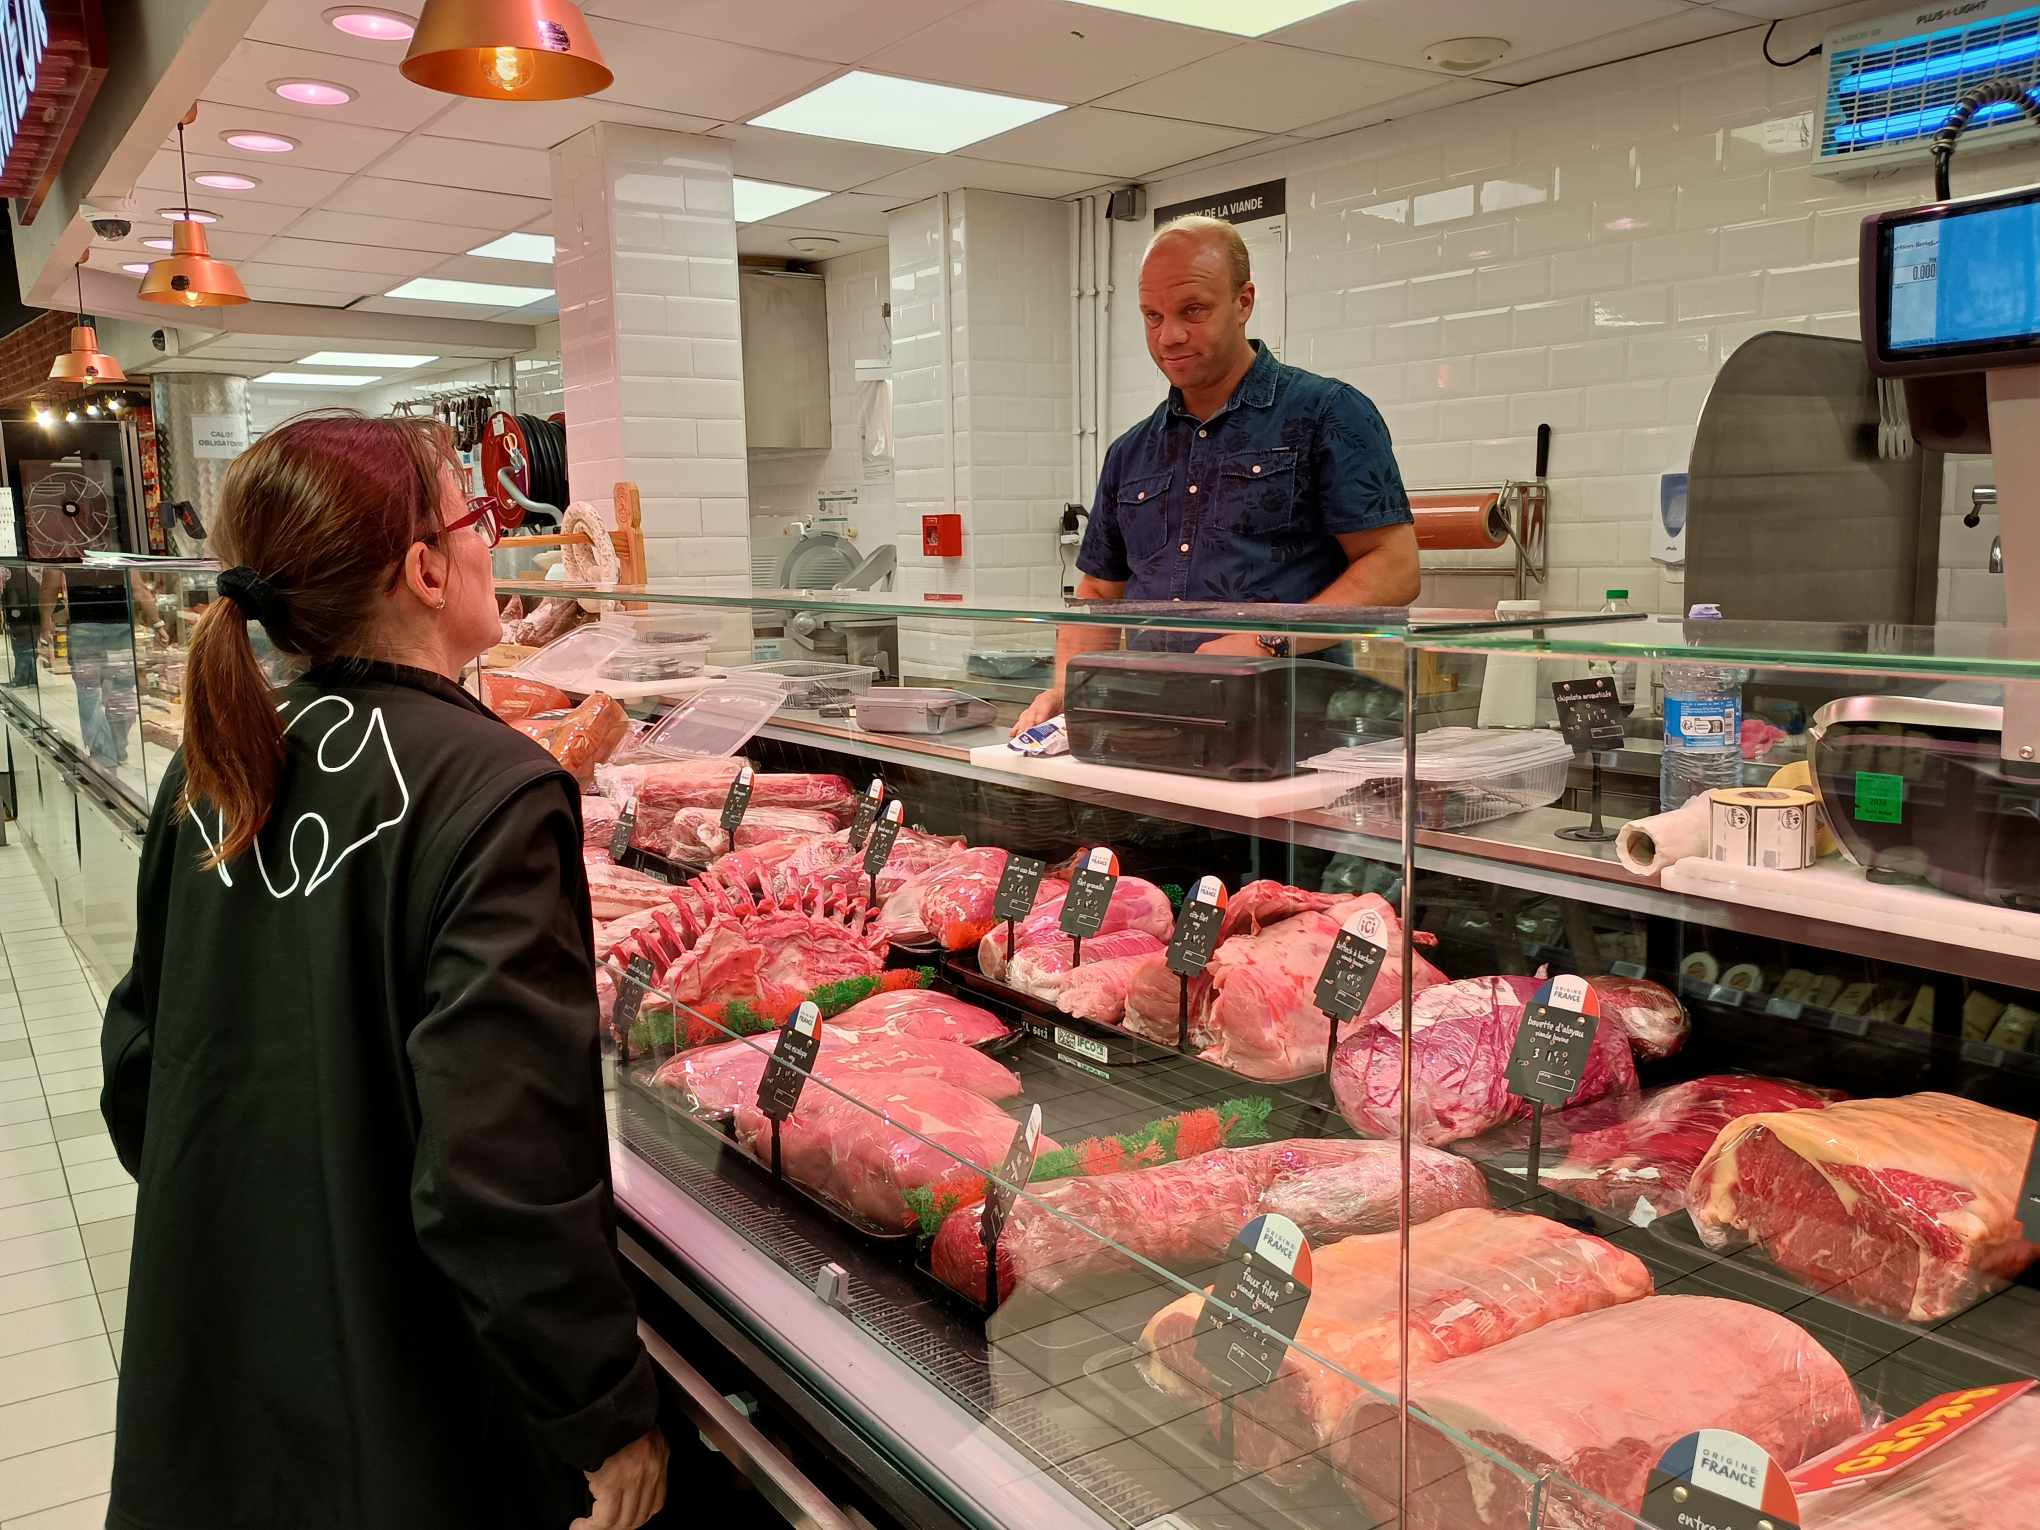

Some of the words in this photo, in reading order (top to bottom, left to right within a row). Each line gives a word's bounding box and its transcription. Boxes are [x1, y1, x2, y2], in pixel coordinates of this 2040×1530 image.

[1217, 205, 1229, 217] LA
[1230, 196, 1264, 215] VIANDE
[1553, 991, 1581, 1003] FRANCE
[1263, 1233, 1293, 1261] FRANCE
[1265, 1227, 1297, 1249] ORIGINE
[1236, 1283, 1257, 1302] viande
[1255, 1294, 1275, 1314] bovine
[1242, 1267, 1261, 1289] faux
[1261, 1279, 1280, 1302] filet
[1832, 1387, 2001, 1474] PROMO
[1700, 1457, 1757, 1489] FRANCE
[1702, 1448, 1760, 1475] ORIGINE
